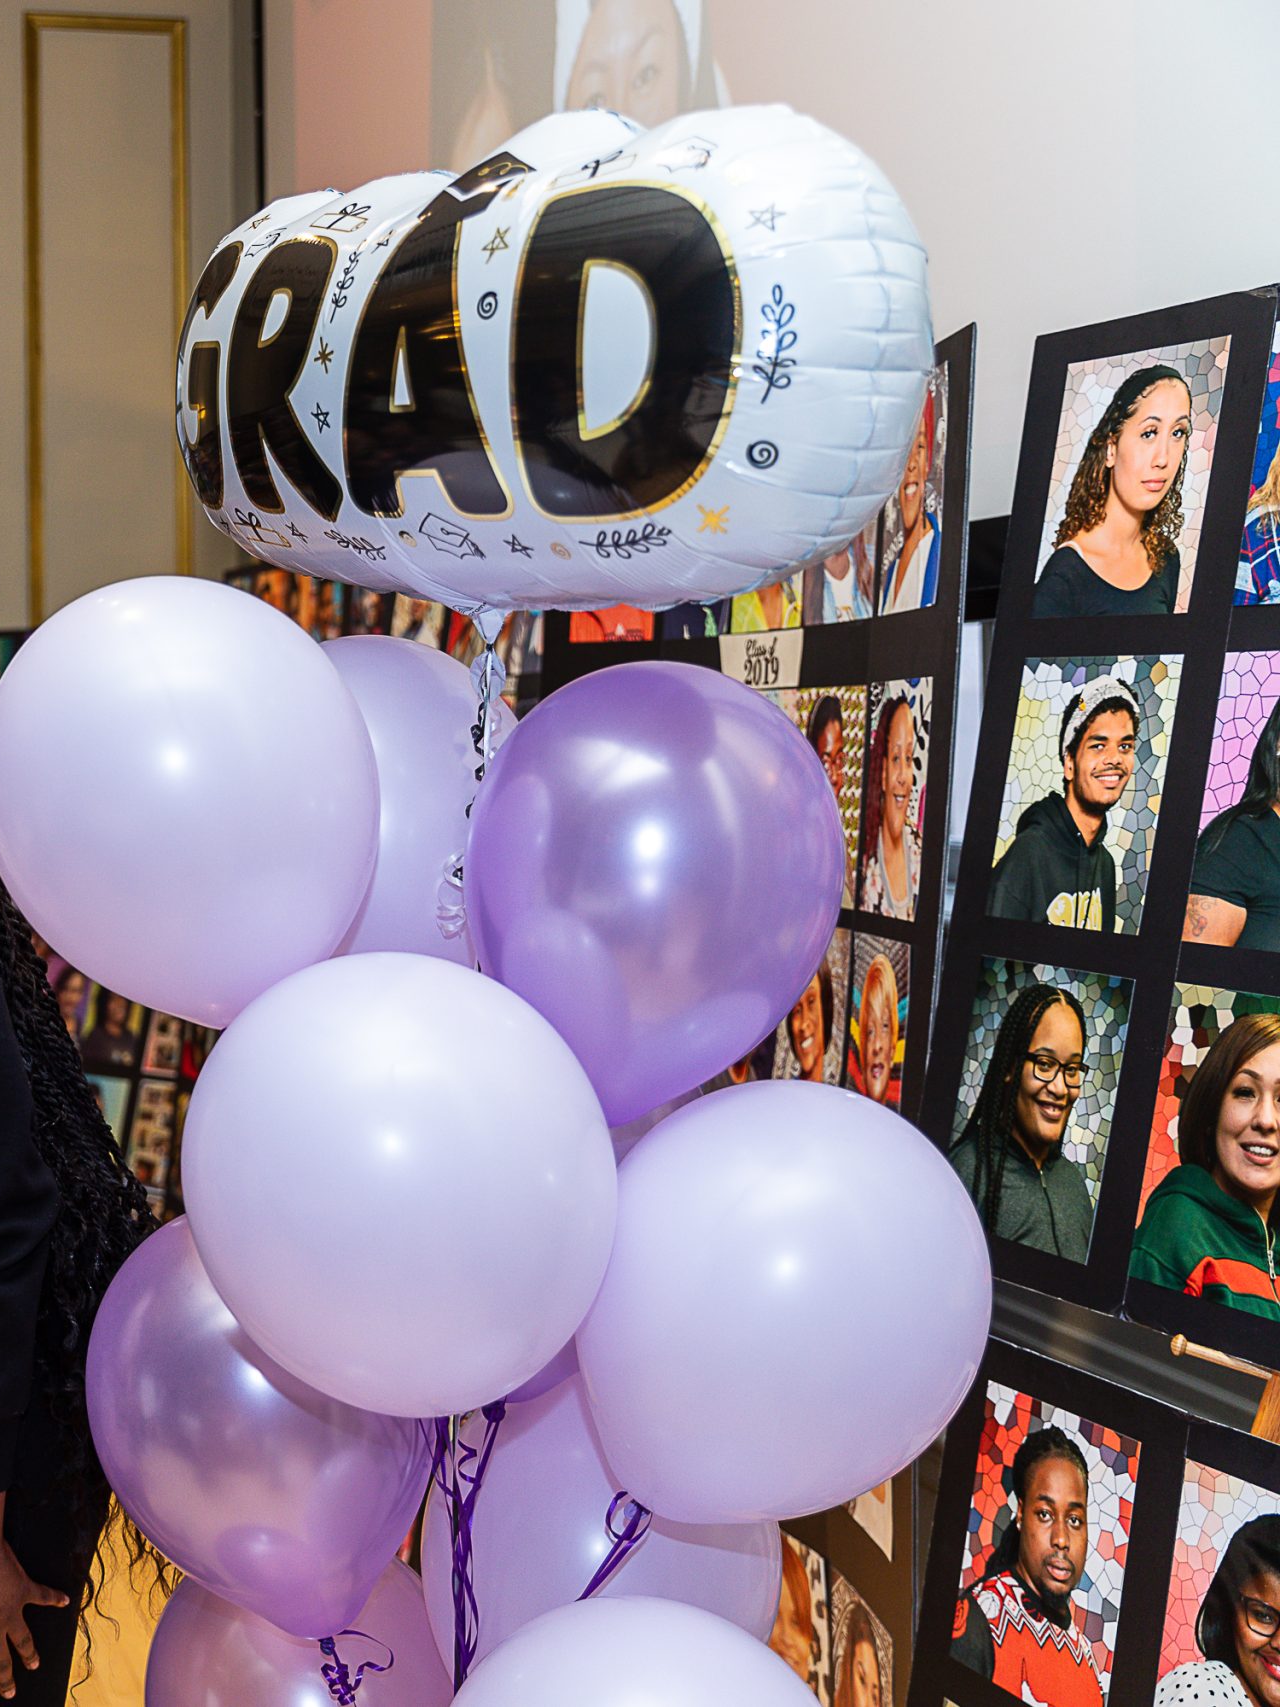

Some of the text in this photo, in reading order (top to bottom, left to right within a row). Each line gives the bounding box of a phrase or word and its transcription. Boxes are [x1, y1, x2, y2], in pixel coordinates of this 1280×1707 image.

[176, 176, 742, 522] GRAD
[745, 639, 767, 658] Class
[744, 656, 779, 685] 2019
